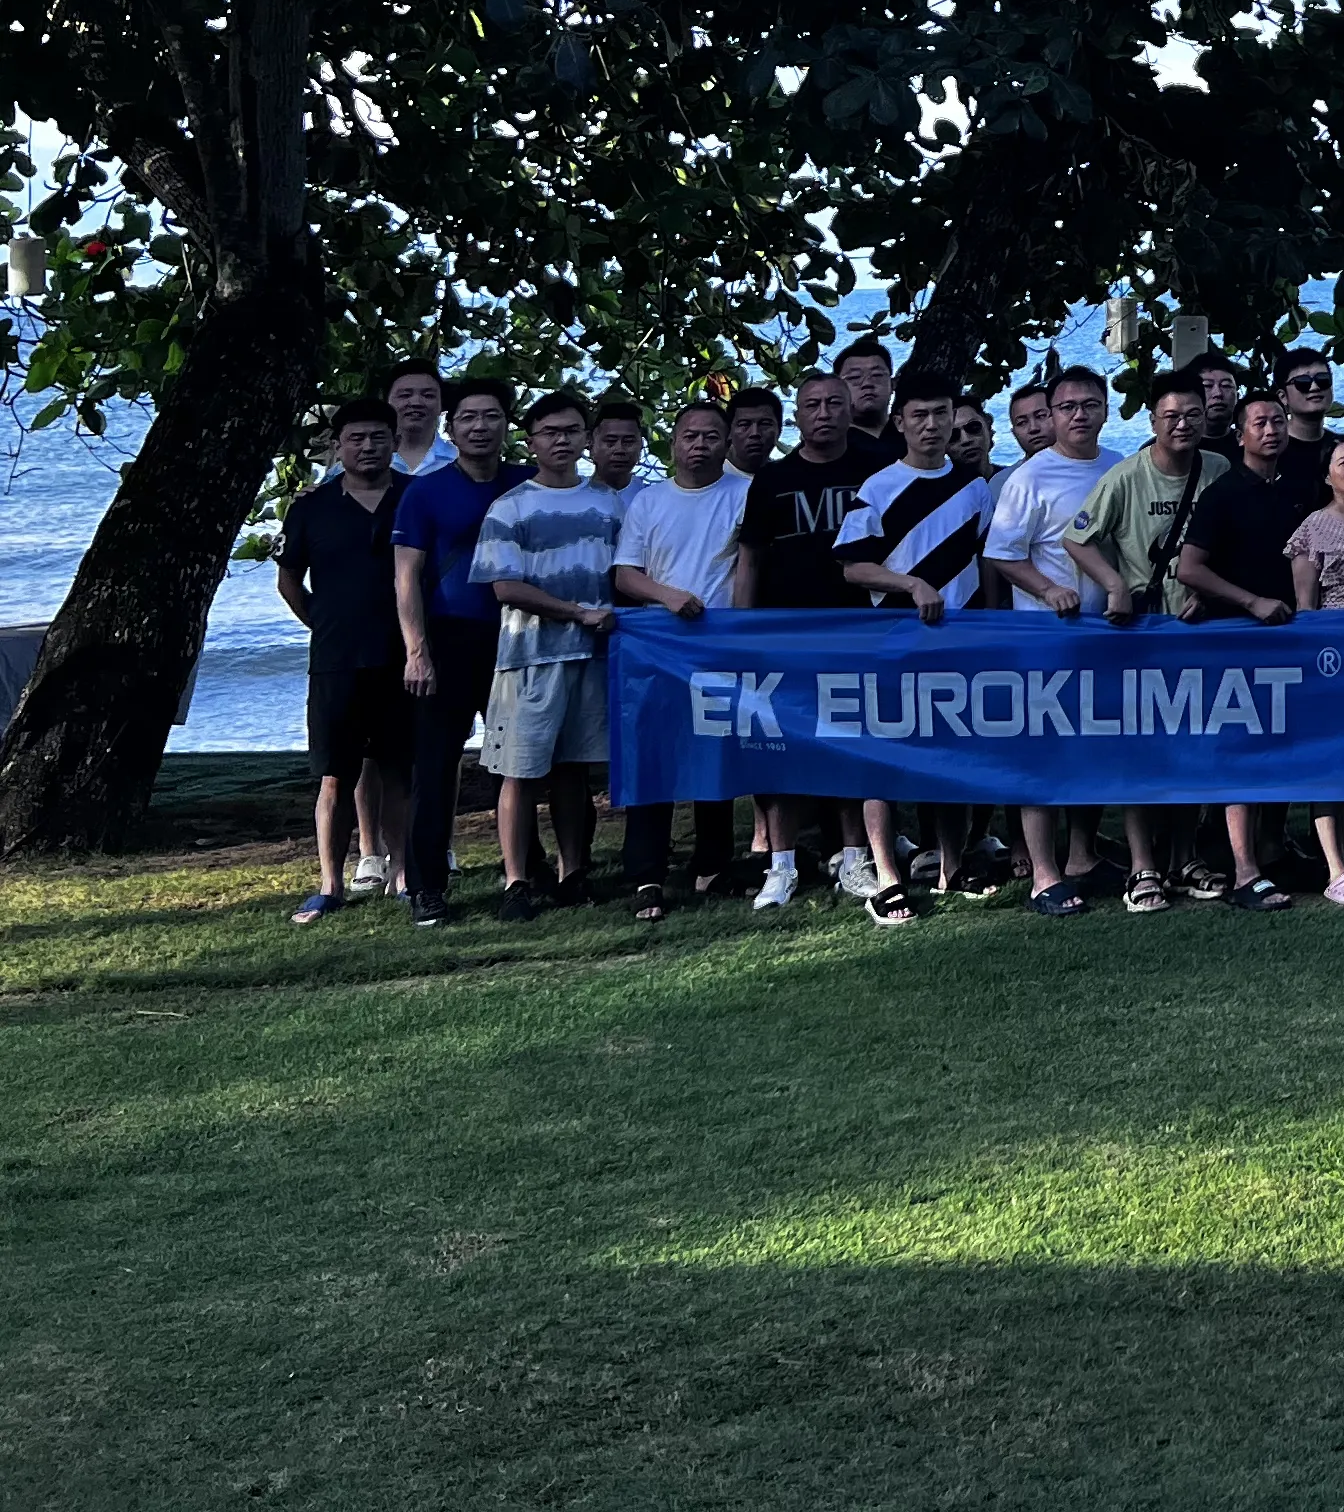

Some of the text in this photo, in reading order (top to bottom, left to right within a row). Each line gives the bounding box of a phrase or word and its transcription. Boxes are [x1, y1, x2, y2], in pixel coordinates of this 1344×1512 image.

[1148, 501, 1179, 516] JUST
[688, 671, 784, 738] EK
[814, 668, 1303, 738] EUROKLIMAT
